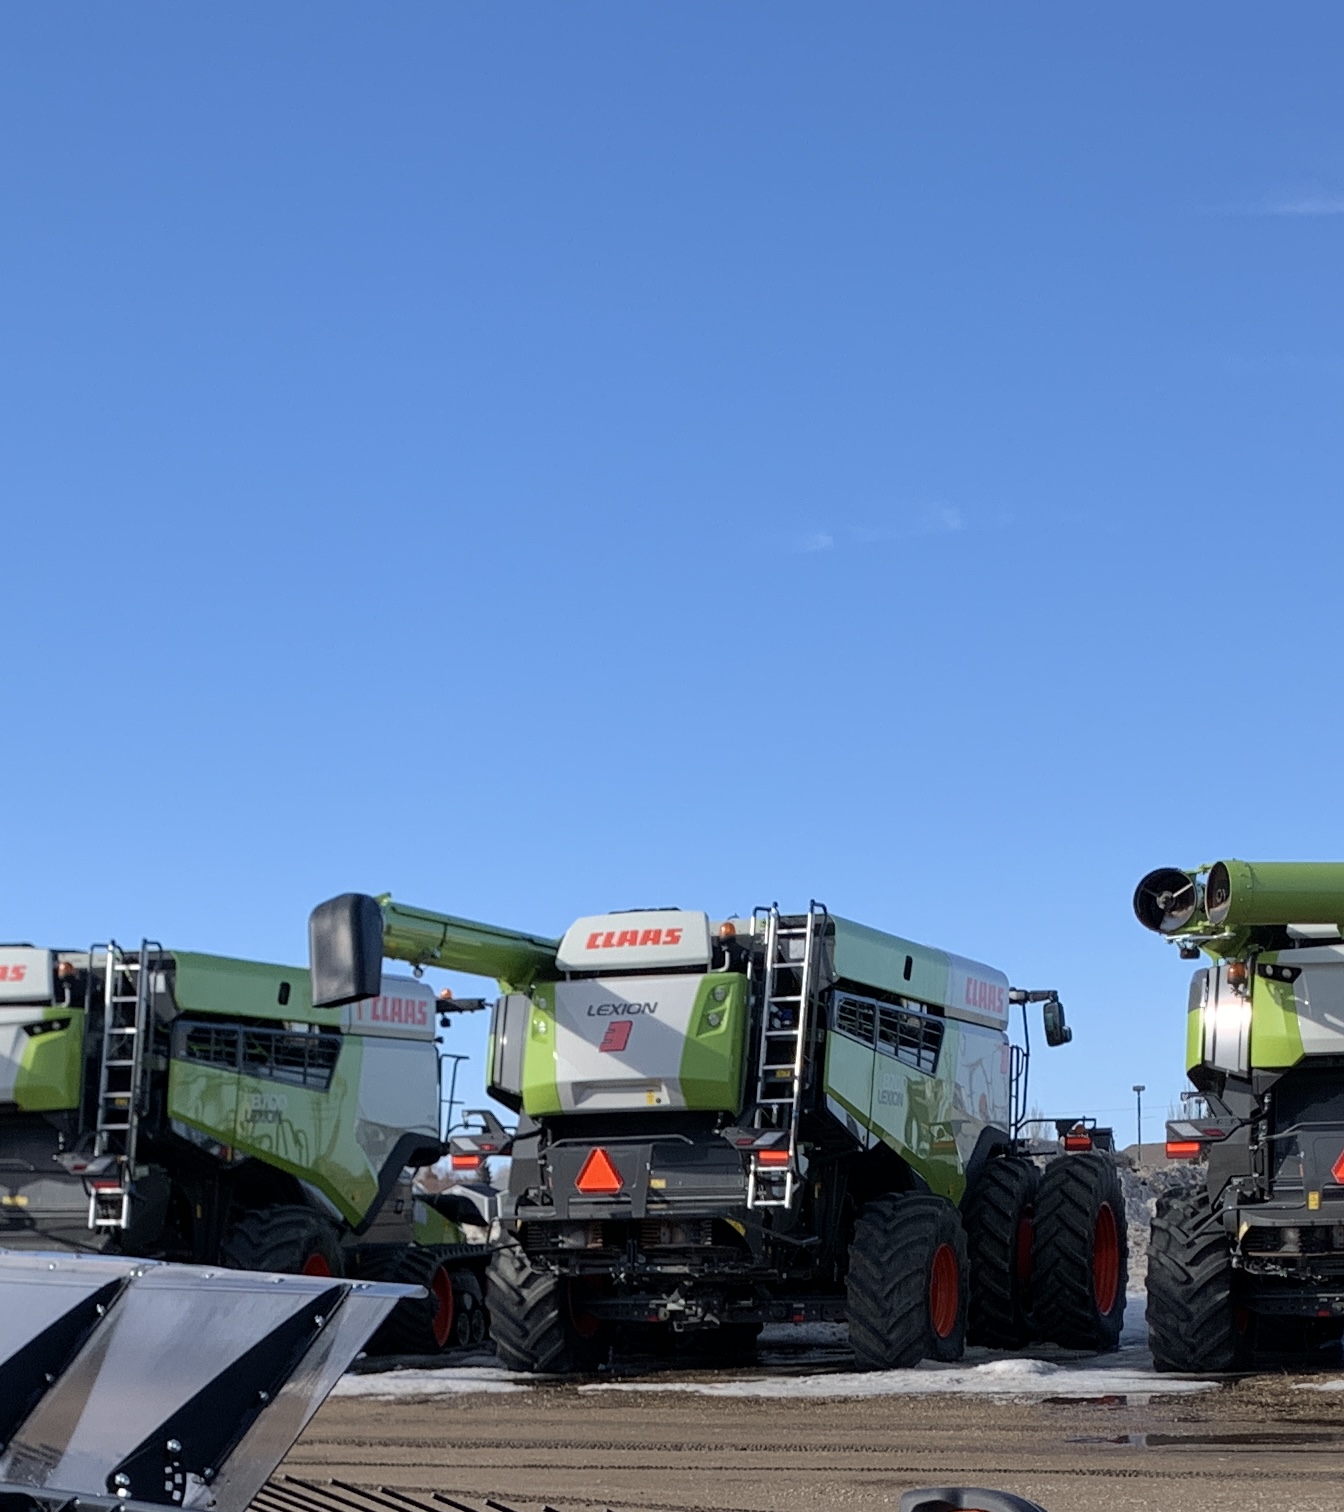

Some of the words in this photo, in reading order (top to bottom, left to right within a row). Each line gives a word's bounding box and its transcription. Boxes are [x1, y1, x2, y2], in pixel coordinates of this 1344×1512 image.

[585, 928, 683, 950] CLAAS
[587, 1001, 659, 1017] LEXION
[965, 976, 1005, 1014] CLAAS
[371, 996, 428, 1025] CLAAS
[599, 1020, 633, 1053] 3
